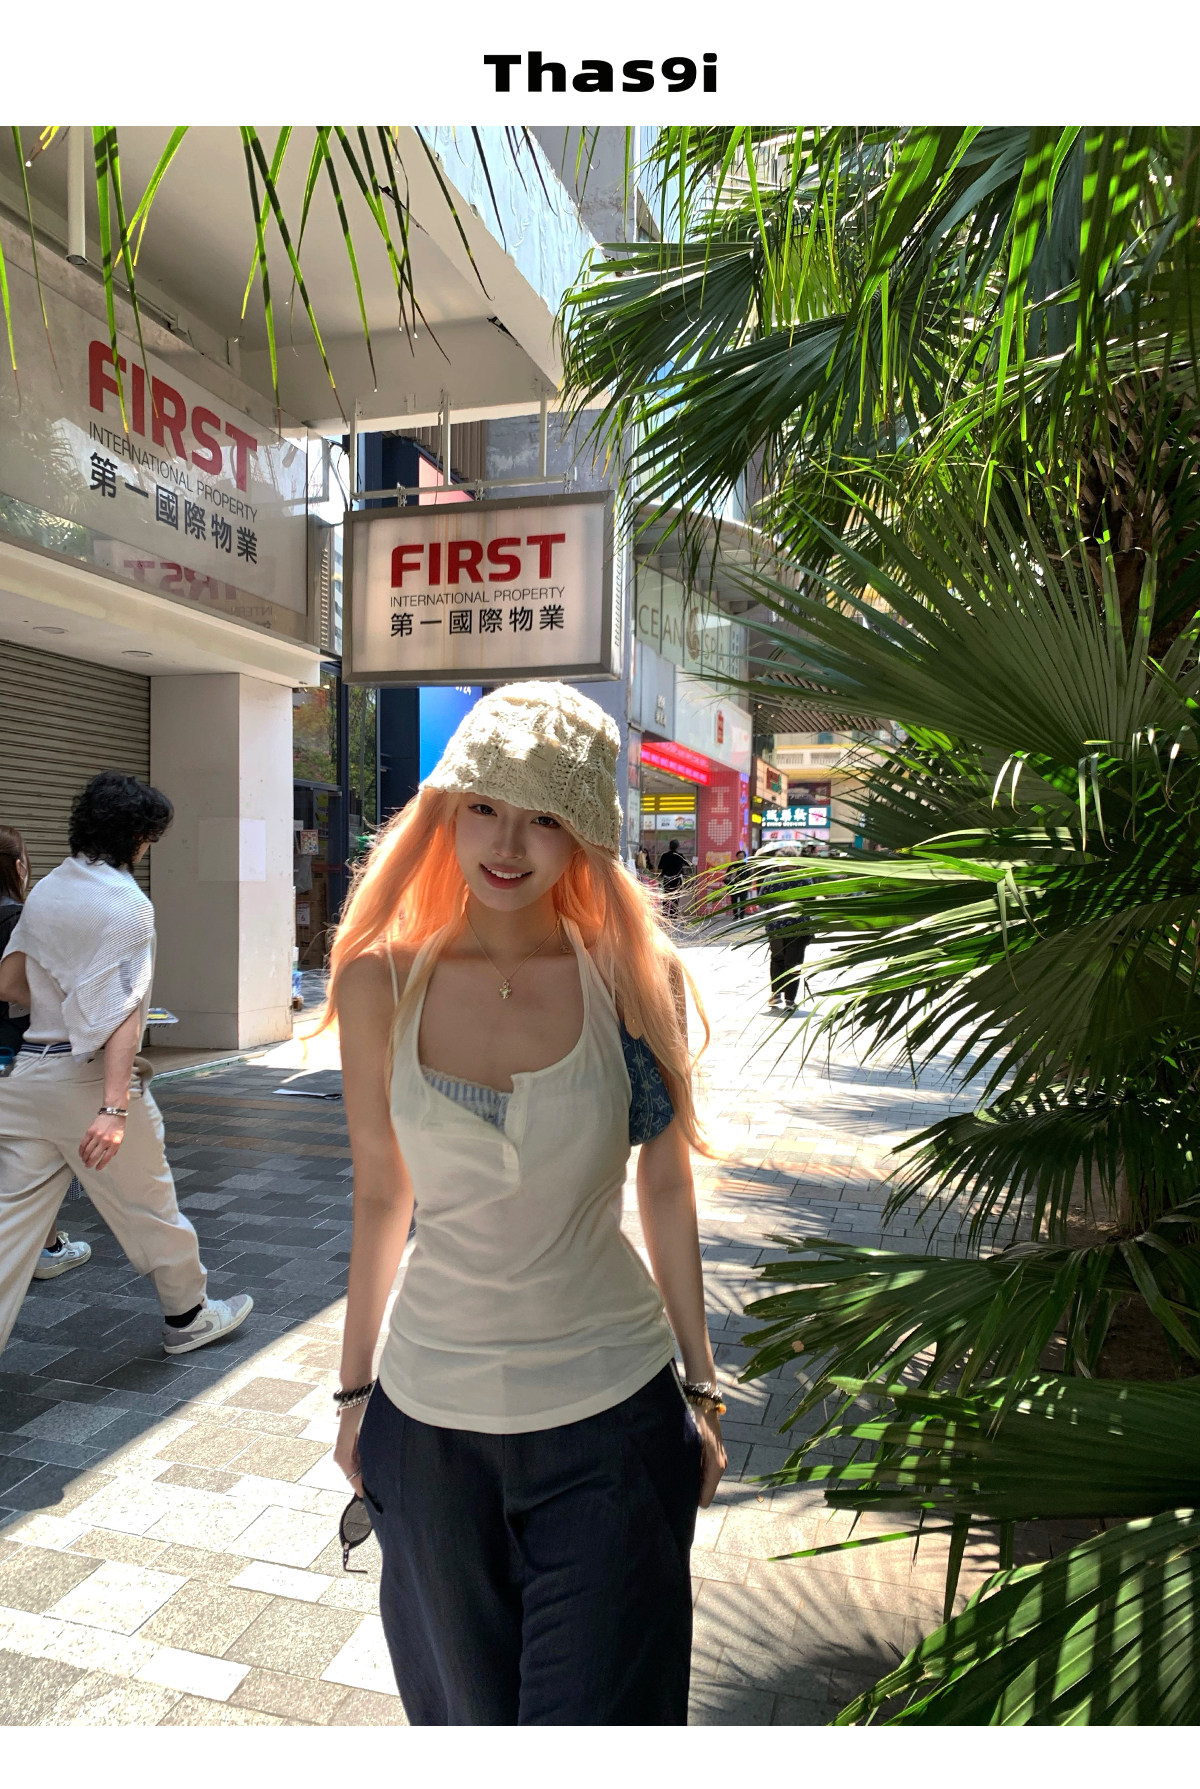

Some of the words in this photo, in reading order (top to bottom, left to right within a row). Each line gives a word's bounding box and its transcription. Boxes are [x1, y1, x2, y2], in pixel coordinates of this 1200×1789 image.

[88, 340, 258, 492] FIRST
[89, 421, 194, 493] INTERNATIONAL
[196, 479, 258, 523] PROPERTY
[89, 451, 258, 565] 第一國際物業
[390, 533, 566, 588] FIRST
[390, 590, 490, 608] INTERNATIONAL
[493, 586, 566, 600] PROPERTY
[390, 604, 565, 638] 第一國際物業
[638, 604, 683, 648] CEAN
